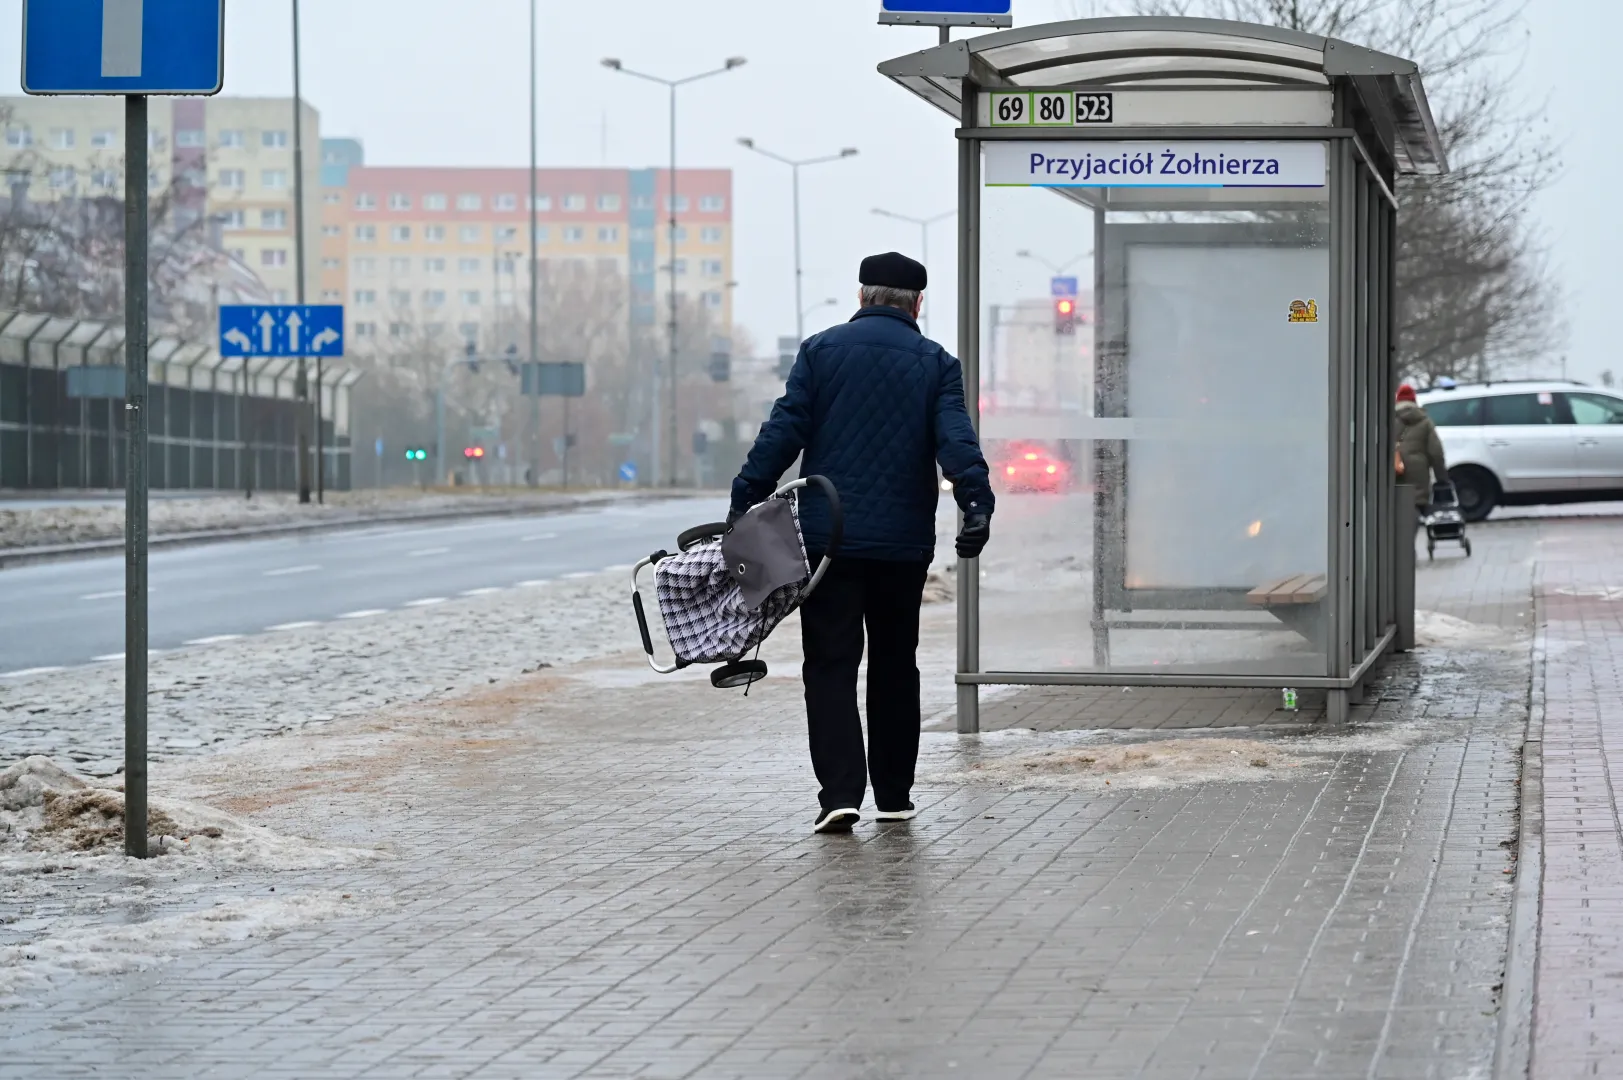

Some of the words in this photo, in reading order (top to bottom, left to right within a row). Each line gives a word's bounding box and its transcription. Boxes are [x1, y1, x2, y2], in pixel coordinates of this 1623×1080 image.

[998, 97, 1024, 121] 69
[1040, 96, 1065, 121] 80
[1077, 96, 1111, 121] 523
[1030, 153, 1154, 180] Przyjaciół
[1160, 149, 1279, 175] Żołnierza
